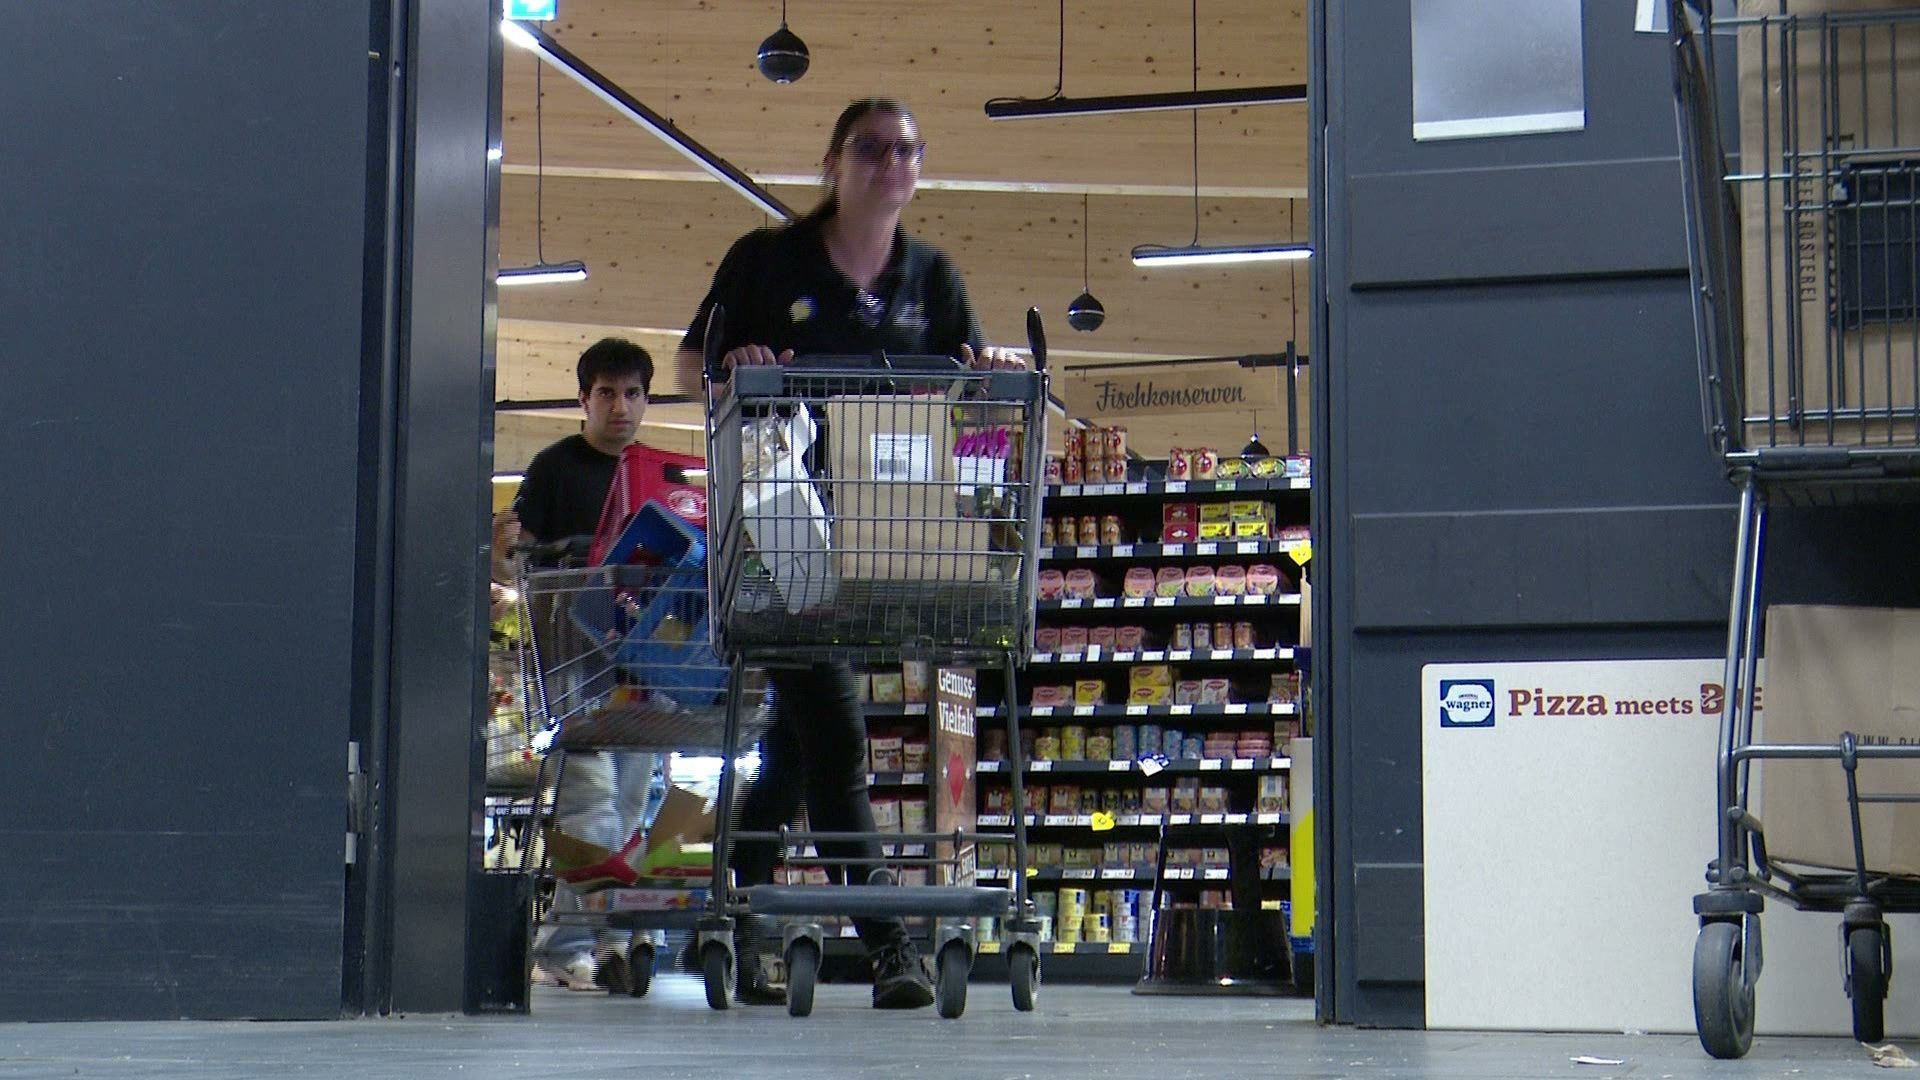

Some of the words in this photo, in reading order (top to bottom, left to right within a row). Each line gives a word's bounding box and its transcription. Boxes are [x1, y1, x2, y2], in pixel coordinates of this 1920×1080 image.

[1094, 380, 1246, 412] Fischkonserven
[938, 668, 976, 700] Genuss-
[1446, 700, 1491, 713] wagner
[1508, 688, 1608, 716] Pizza
[1615, 696, 1694, 715] meets
[938, 701, 975, 738] Vielfalt
